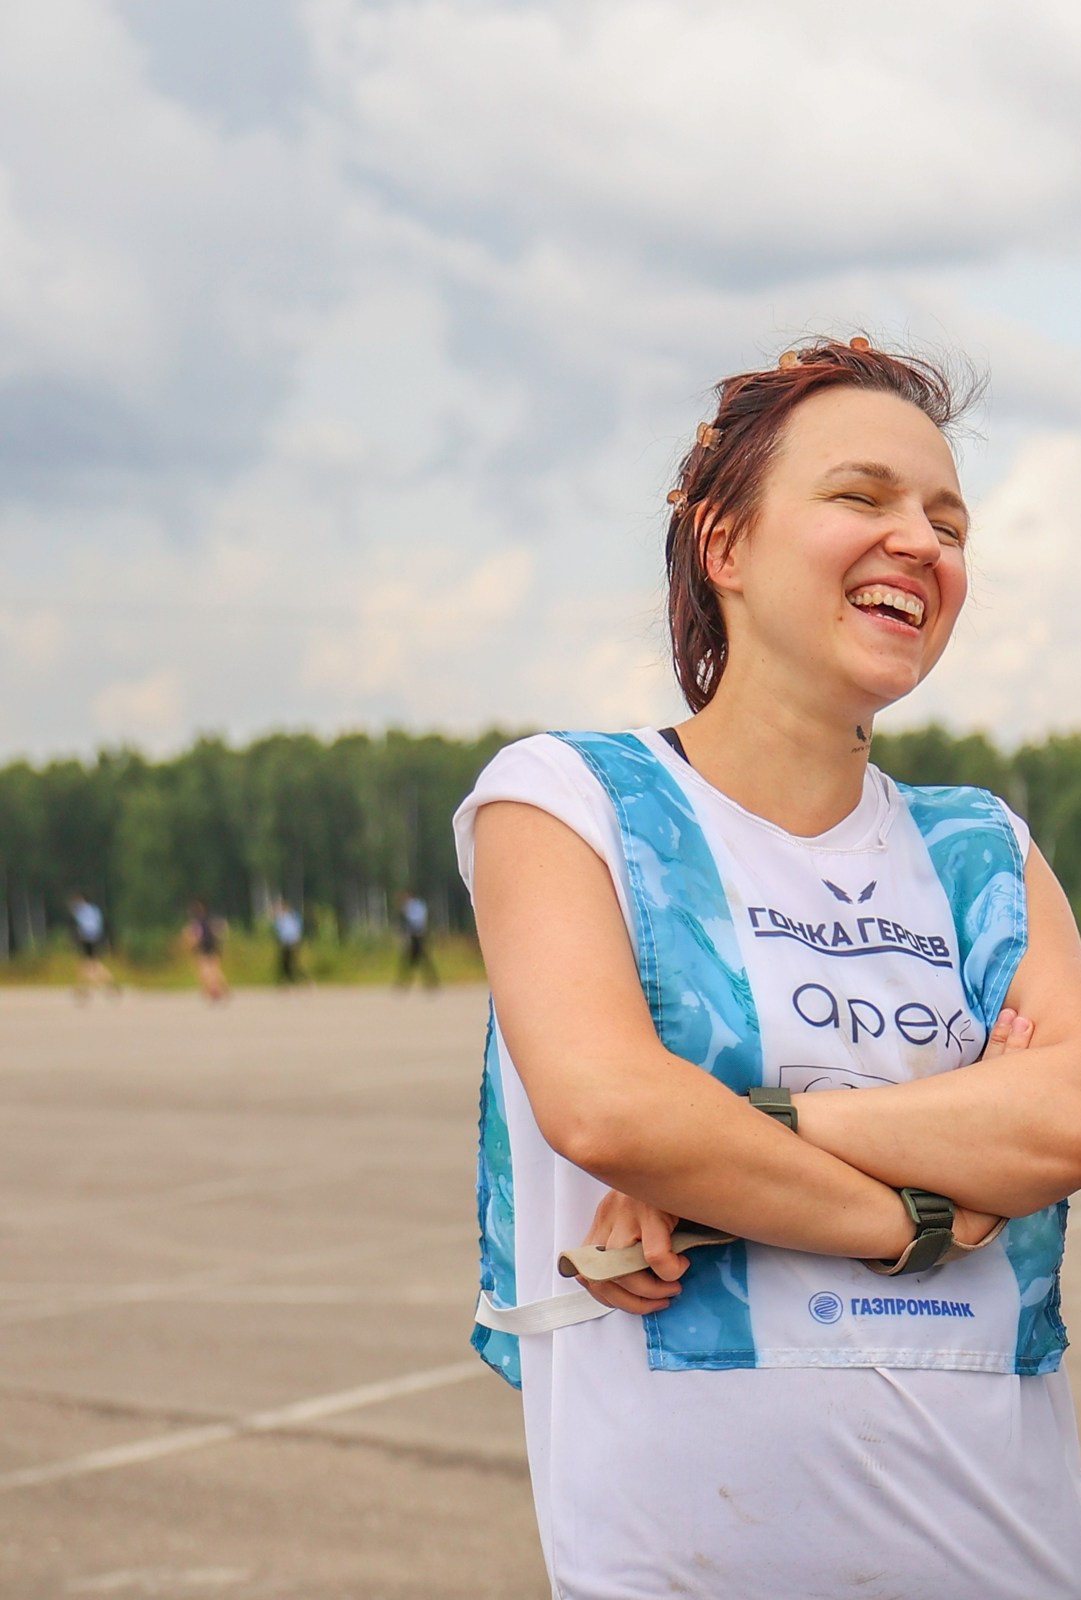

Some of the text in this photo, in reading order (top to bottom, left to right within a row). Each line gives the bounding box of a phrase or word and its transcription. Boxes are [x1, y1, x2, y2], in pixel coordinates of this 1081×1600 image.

[748, 907, 951, 957] ГОНКА ГЕРОЕВ
[851, 1298, 975, 1317] ГАЗПРОМБАНК
